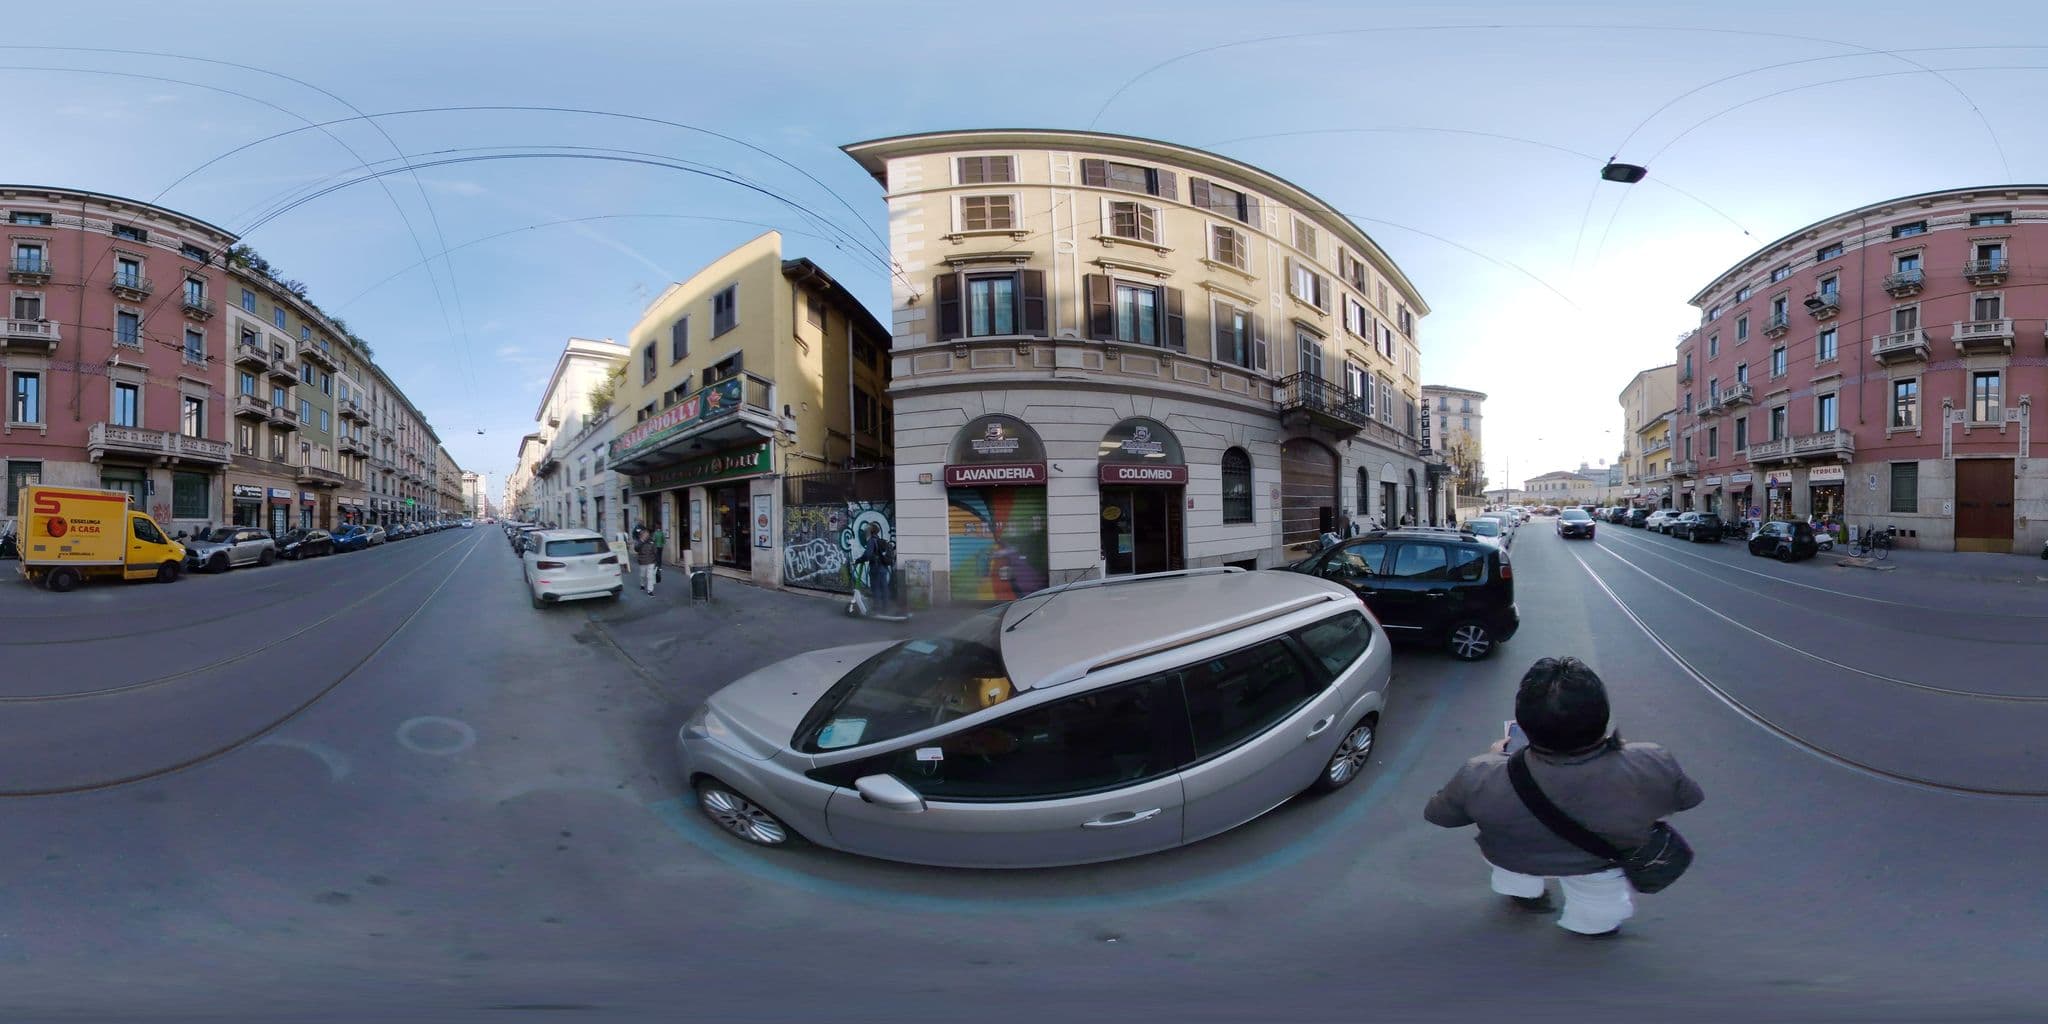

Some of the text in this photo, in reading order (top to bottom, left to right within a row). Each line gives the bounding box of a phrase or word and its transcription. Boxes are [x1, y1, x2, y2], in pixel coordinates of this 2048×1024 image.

[656, 400, 698, 431] JOLLY
[1422, 399, 1430, 447] HOTEL
[955, 467, 1035, 481] LAVANDERIA
[1119, 468, 1173, 480] COLOMBO
